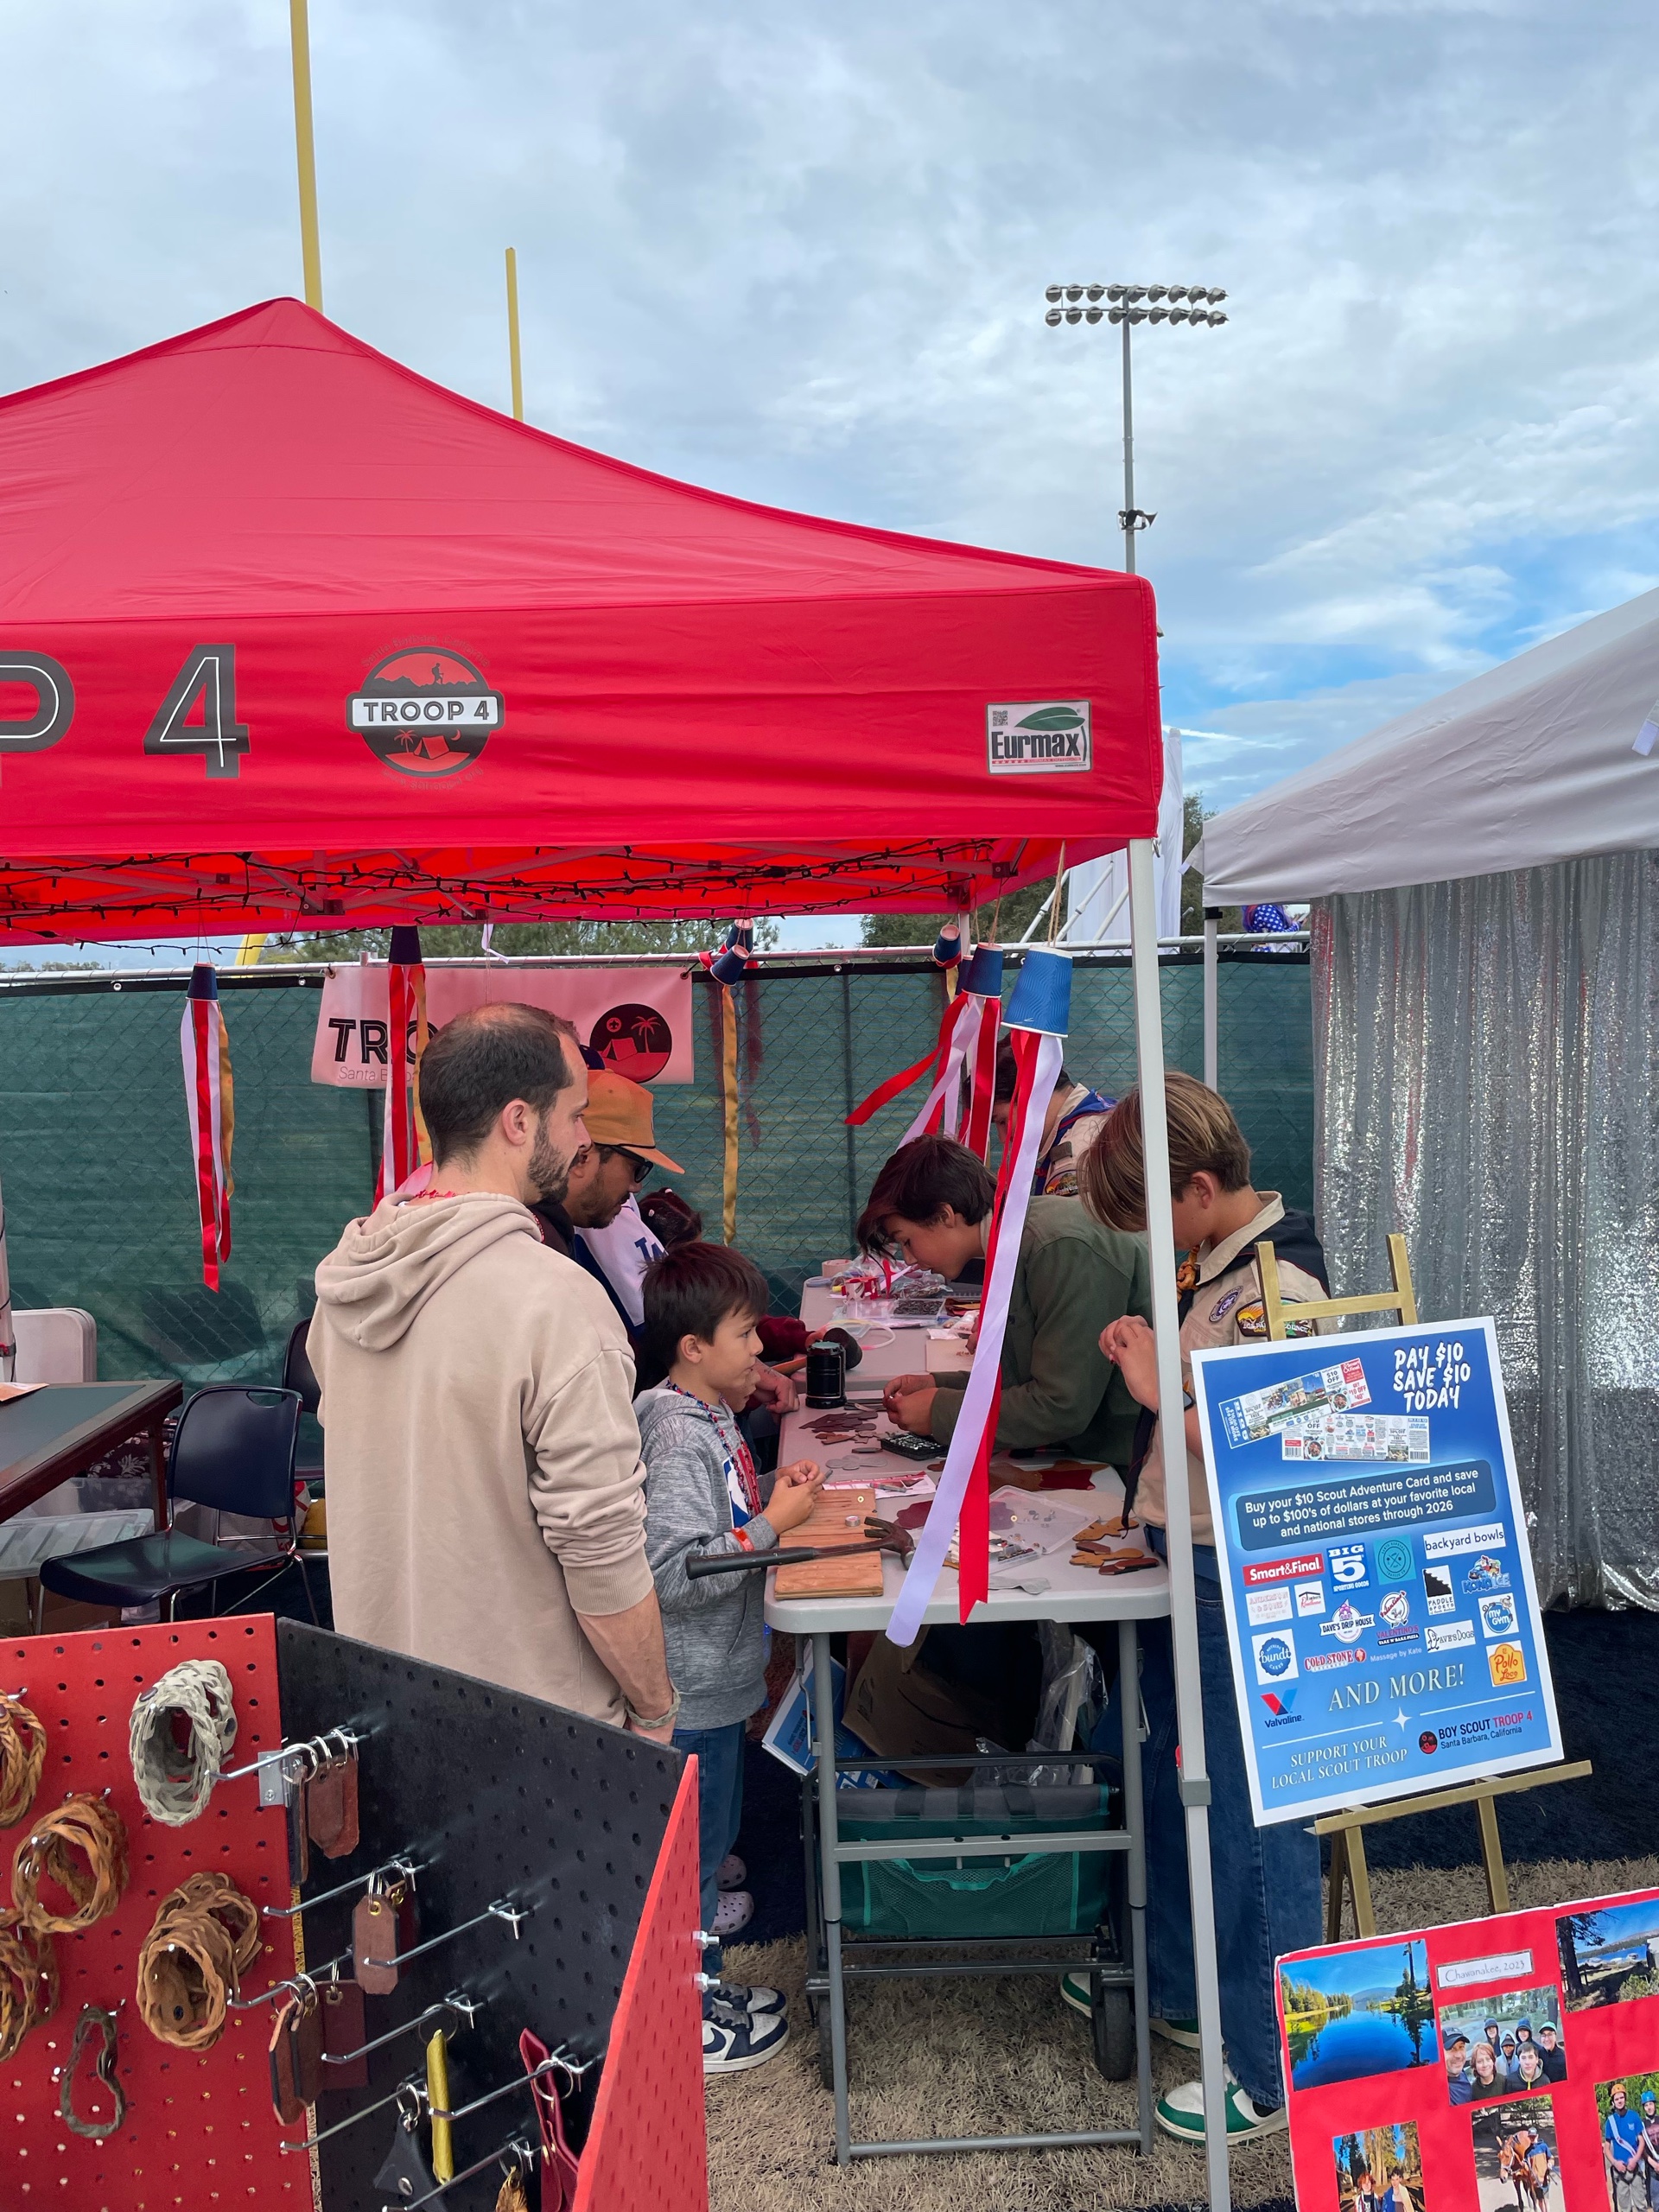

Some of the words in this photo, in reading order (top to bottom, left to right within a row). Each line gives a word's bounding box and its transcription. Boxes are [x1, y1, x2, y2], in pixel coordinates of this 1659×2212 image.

[143, 643, 251, 779] 4
[364, 701, 465, 722] TROOP
[474, 700, 490, 721] 4
[991, 731, 1081, 760] Eurmax
[328, 1018, 439, 1065] TRO
[339, 1066, 376, 1081] Santa
[1394, 1345, 1429, 1371] PAY
[1435, 1342, 1464, 1369] $10
[1393, 1367, 1436, 1392] SAVE
[1443, 1363, 1471, 1389] $10
[1403, 1385, 1460, 1414] TODAY
[1245, 1502, 1266, 1514] Buy
[1268, 1497, 1292, 1511] your
[1295, 1492, 1313, 1506] $10
[1317, 1488, 1347, 1502] Scout
[1350, 1481, 1403, 1497] Adventure
[1406, 1475, 1431, 1488] Card
[1433, 1471, 1452, 1484] and
[1455, 1470, 1478, 1481] save
[1253, 1516, 1267, 1529] up
[1269, 1514, 1281, 1524] to
[1283, 1508, 1317, 1522] $100's
[1320, 1504, 1331, 1516] of
[1333, 1500, 1369, 1514] dollars
[1371, 1497, 1382, 1508] at
[1383, 1495, 1408, 1509] your
[1410, 1487, 1449, 1502] favorite
[1451, 1483, 1476, 1496] local
[1281, 1524, 1300, 1537] and
[1304, 1517, 1345, 1534] national
[1348, 1515, 1381, 1527] stores
[1382, 1505, 1423, 1521] through
[1426, 1500, 1453, 1514] 2026
[1328, 1545, 1364, 1557] BIG
[1425, 1534, 1471, 1551] backyard
[1474, 1529, 1504, 1543] bowls
[1249, 1557, 1320, 1580] Smart&Final
[1332, 1554, 1366, 1583] 5
[1462, 1578, 1492, 1593] KONA
[1492, 1573, 1511, 1588] ICE
[1428, 1597, 1453, 1606] PADDLE
[1322, 1622, 1340, 1633] DAVE'S
[1341, 1620, 1354, 1629] DRIP
[1355, 1617, 1373, 1627] HOUSE
[1489, 1609, 1501, 1618] MY
[1492, 1617, 1510, 1625] GYM
[1376, 1625, 1419, 1638] VALENTINO'S
[1261, 1647, 1291, 1663] bundt
[1305, 1656, 1325, 1670] COLD
[1327, 1650, 1353, 1664] STONE
[1370, 1651, 1398, 1662] Massage
[1494, 1651, 1518, 1674] Pollo
[1500, 1669, 1518, 1681] Loco
[1328, 1681, 1380, 1712] AND
[1389, 1663, 1464, 1699] MORE!
[1264, 1714, 1303, 1728] Valvoline
[1439, 1726, 1458, 1739] BOY
[1459, 1719, 1491, 1735] SCOUT
[1492, 1713, 1523, 1728] TROOP
[1526, 1711, 1533, 1721] 4
[1440, 1739, 1460, 1750] Santa
[1462, 1733, 1490, 1745] Barbara,
[1491, 1726, 1522, 1738] California
[1290, 1743, 1349, 1768] SUPPORT
[1352, 1736, 1388, 1754] YOUR
[1271, 1769, 1315, 1789] LOCAL
[1319, 1758, 1361, 1779] SCOUT
[1364, 1748, 1408, 1769] TROOP
[1445, 1963, 1502, 1982] Chawanakee,
[1503, 1960, 1525, 1971] 2023
